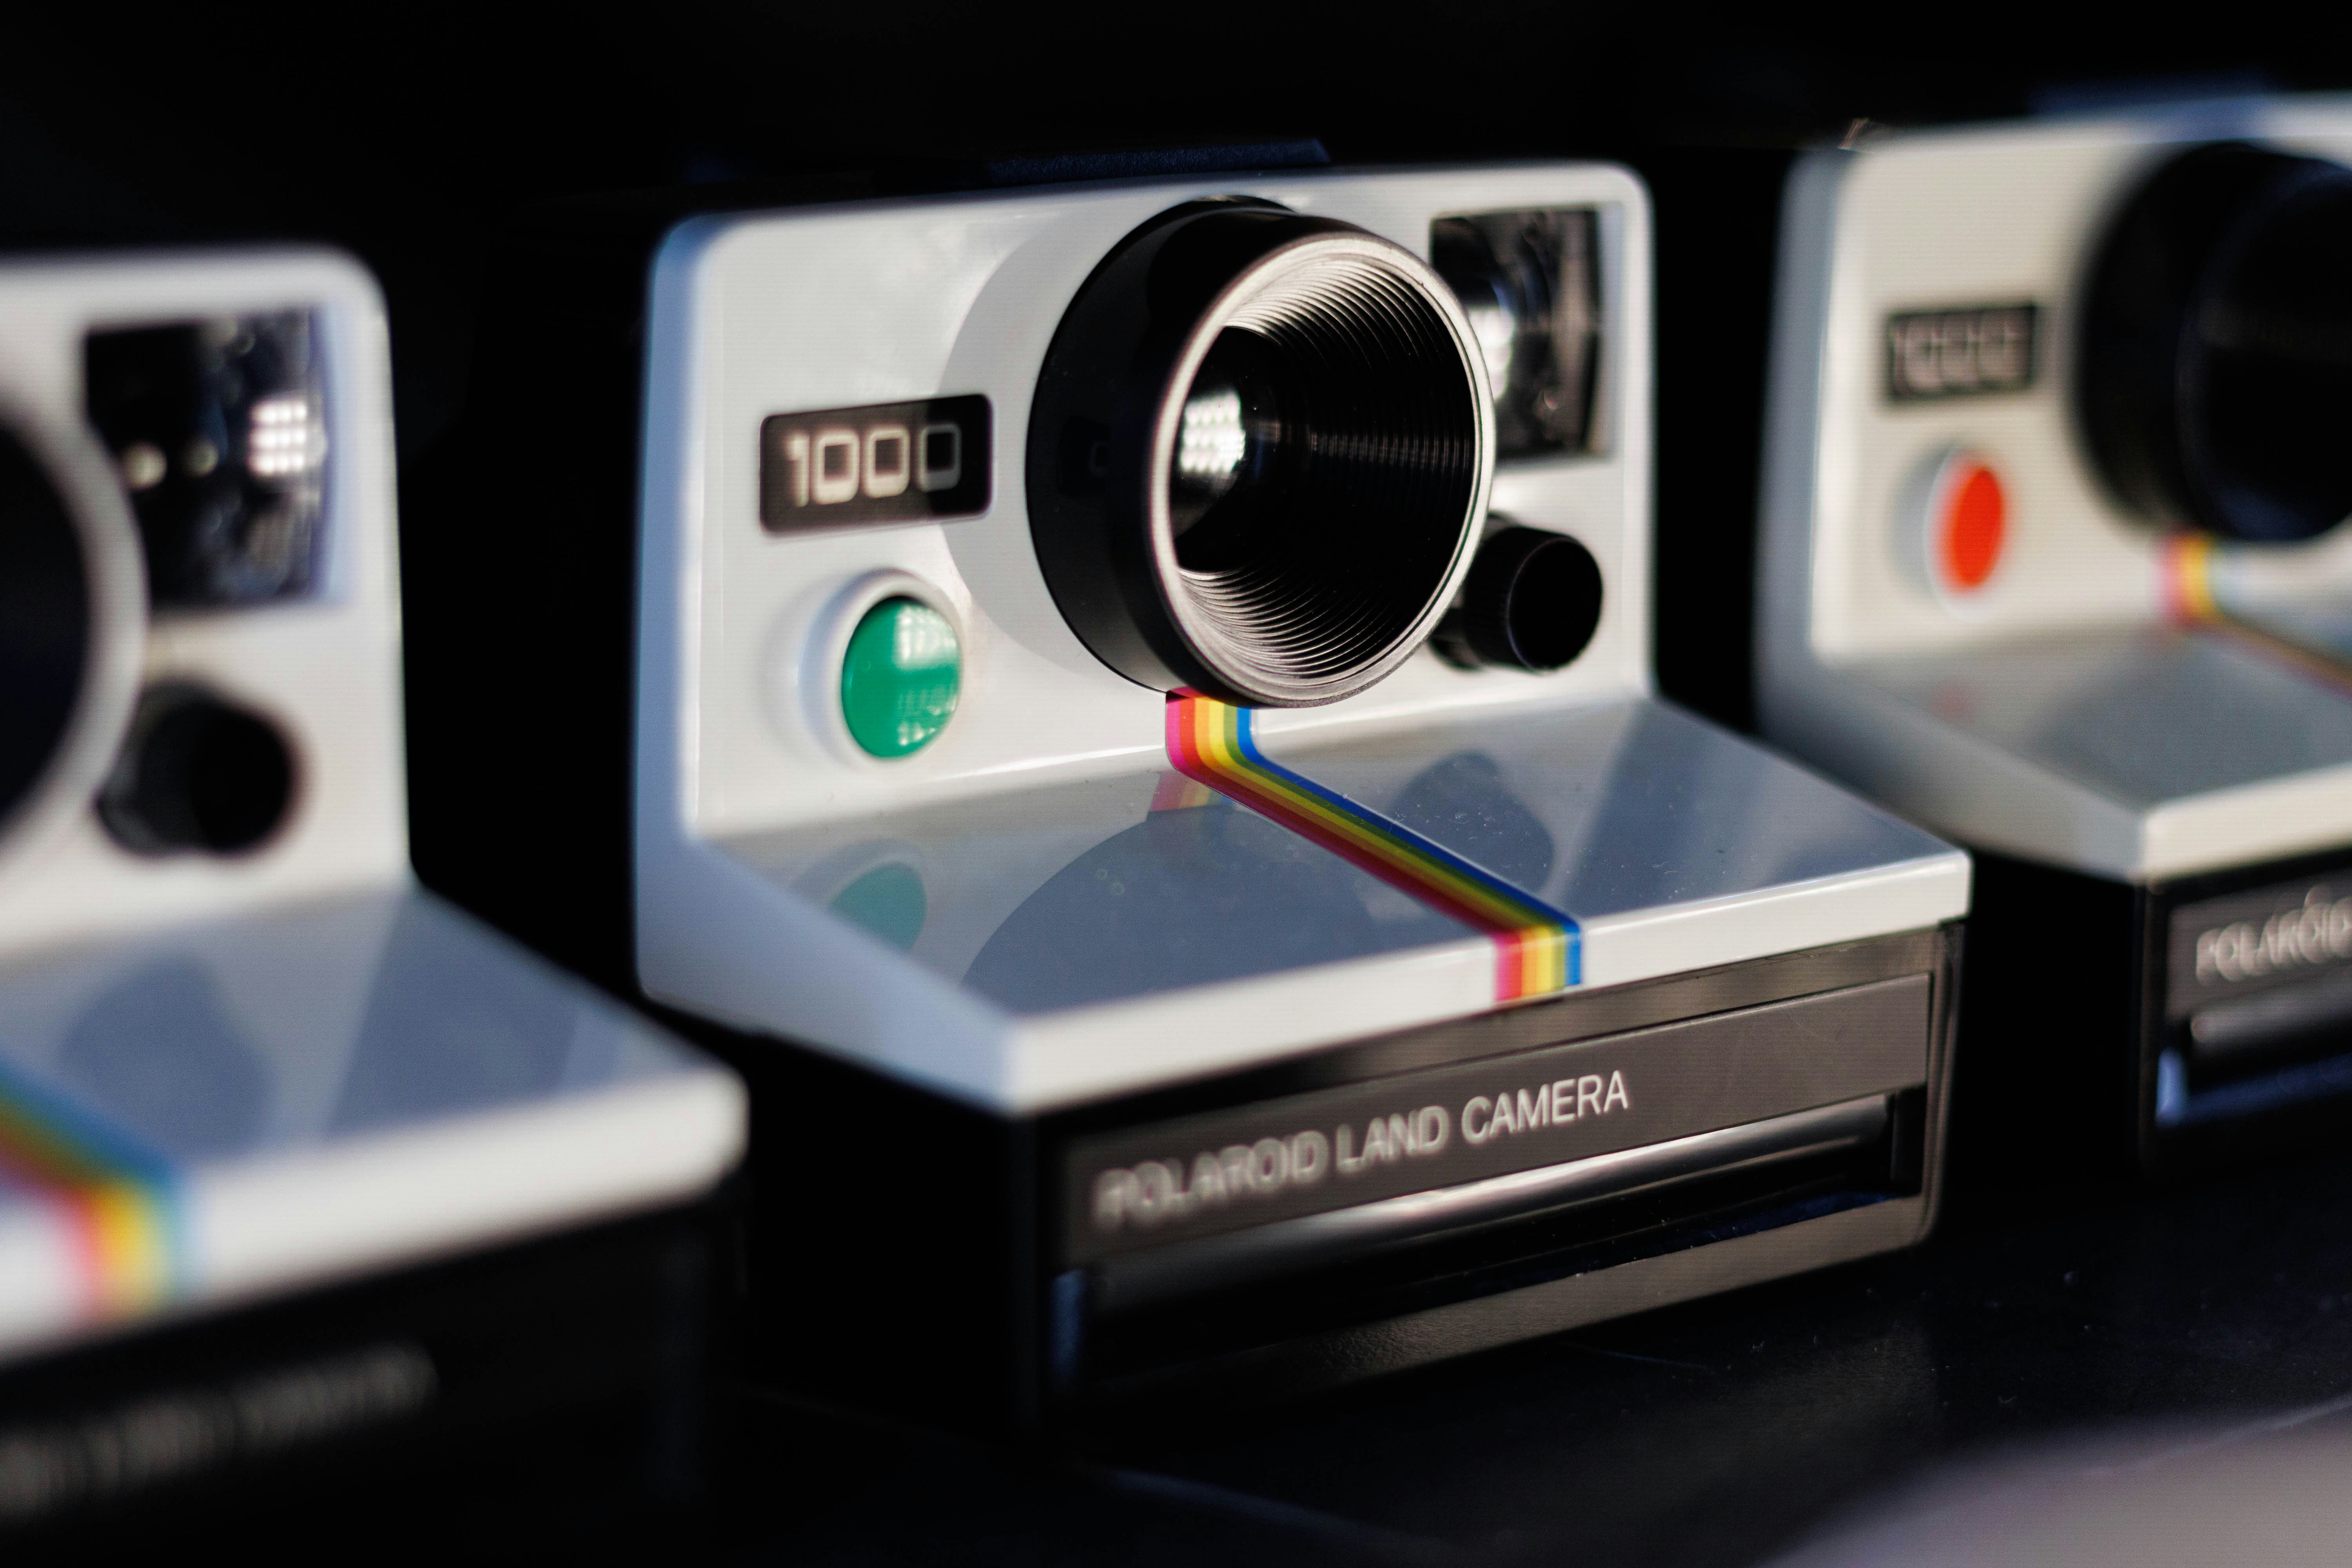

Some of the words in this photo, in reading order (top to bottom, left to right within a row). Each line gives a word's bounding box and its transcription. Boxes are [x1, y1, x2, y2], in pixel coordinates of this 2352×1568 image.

[786, 423, 961, 507] 1000
[1095, 1130, 1329, 1227] POLAROID
[1336, 1105, 1450, 1173] LAND
[1461, 1070, 1629, 1145] CAMERA
